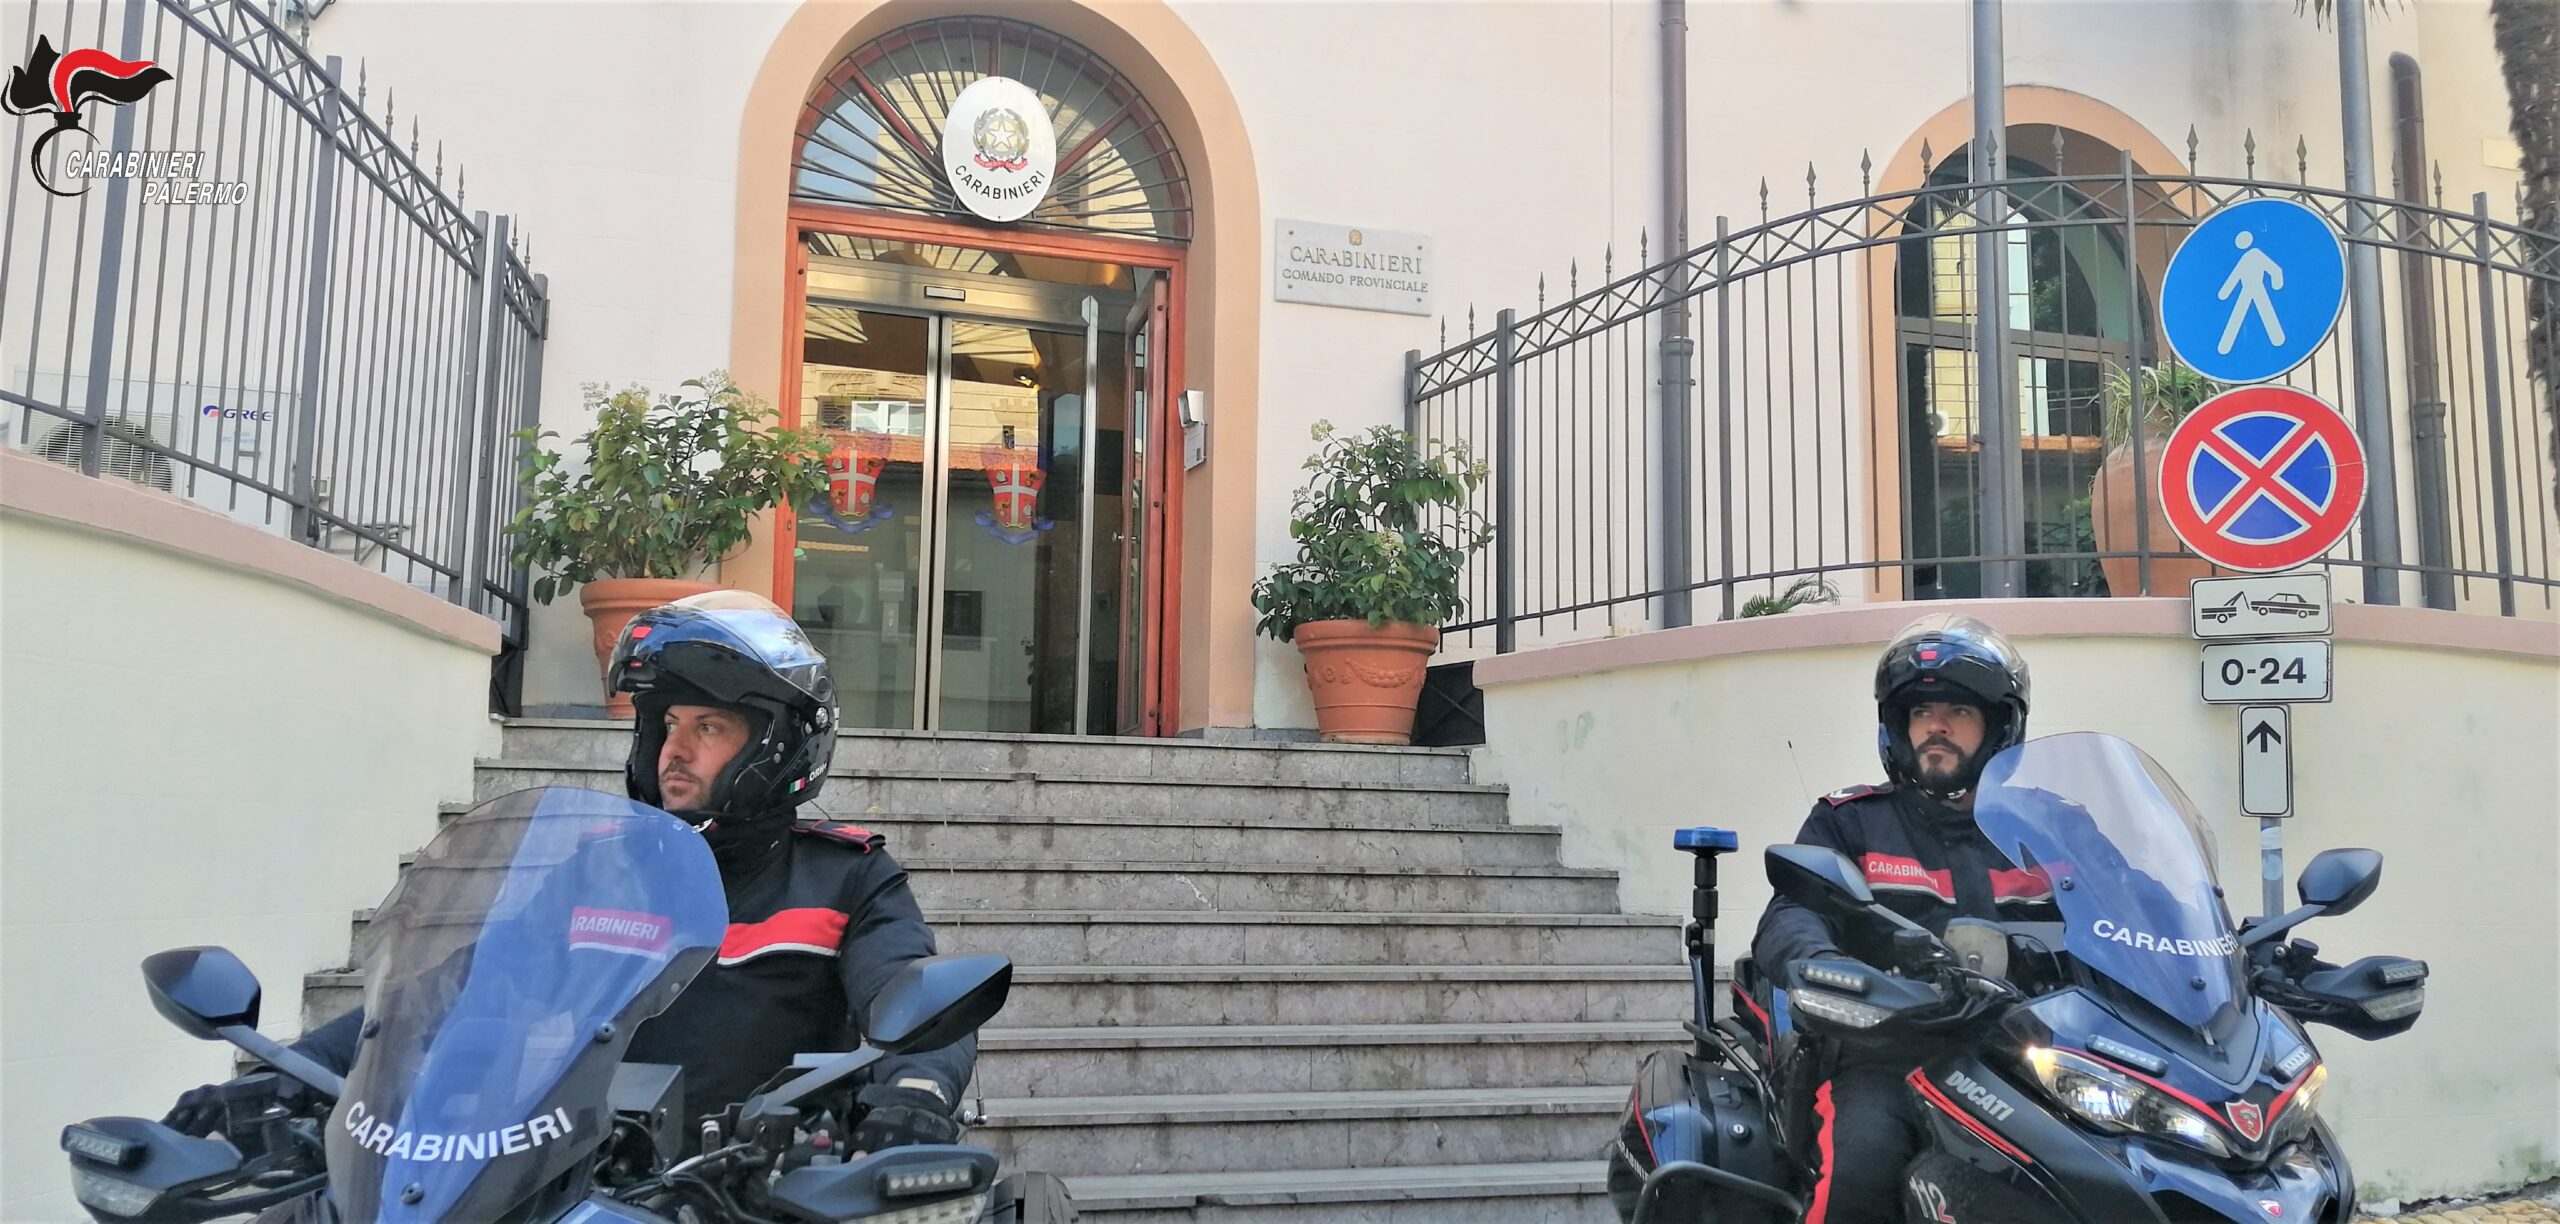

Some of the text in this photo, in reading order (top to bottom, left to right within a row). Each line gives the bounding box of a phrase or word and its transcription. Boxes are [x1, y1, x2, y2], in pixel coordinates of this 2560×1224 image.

[955, 165, 1045, 200] CARABINIERI
[1290, 246, 1422, 274] CARABINIERI
[1282, 268, 1429, 293] COMANDO PROVINCIALE
[223, 408, 274, 421] GREE
[2221, 657, 2307, 686] 0-24
[2093, 919, 2239, 957] CARABINIERI
[1944, 1070, 2015, 1122] DUCATI
[345, 1100, 573, 1162] CARABINIERI
[1909, 1176, 1957, 1224] 112
